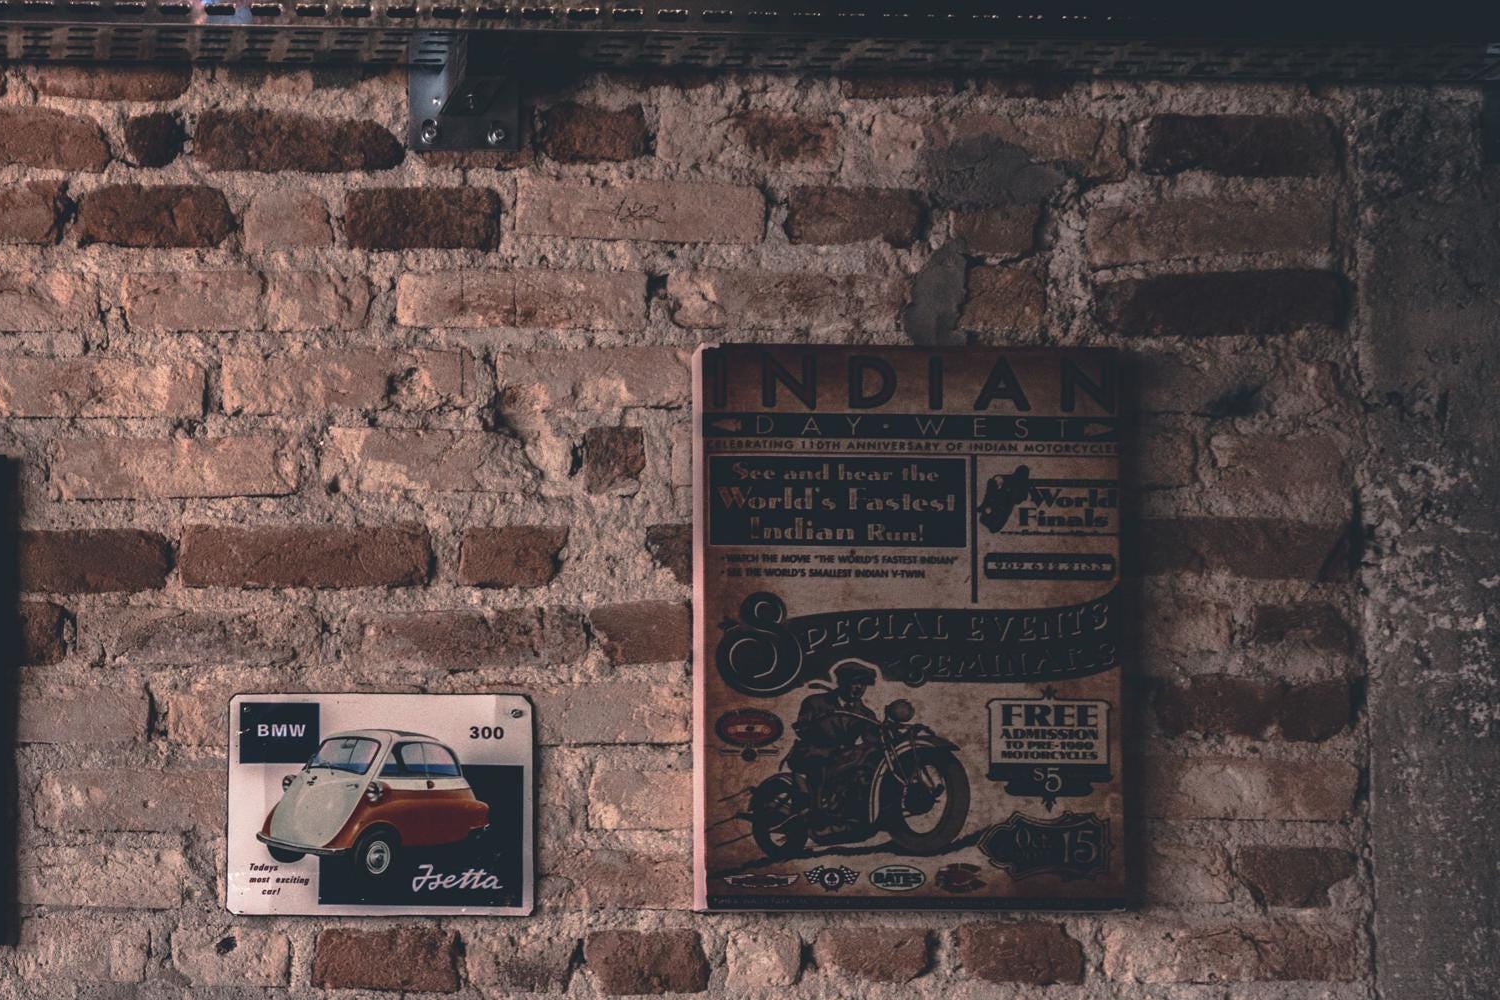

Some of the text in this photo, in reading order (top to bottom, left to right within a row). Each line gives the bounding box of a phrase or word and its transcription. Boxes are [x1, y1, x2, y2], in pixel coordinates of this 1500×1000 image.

[711, 353, 1116, 414] INDIAN
[756, 415, 1071, 439] DAY WEST
[706, 439, 794, 449] CELEBRATING
[801, 440, 841, 450] 110TH
[846, 441, 942, 451] ANNIVERSARY
[945, 442, 963, 451] OF
[969, 442, 1020, 452] INDIAN
[731, 461, 940, 483] See and hear the
[717, 486, 956, 512] World's Fastest
[1028, 487, 1117, 507] World
[1018, 507, 1109, 527] Finals
[750, 515, 924, 542] Indian Run!
[1001, 704, 1098, 727] FREE
[257, 724, 306, 737] BMW
[469, 726, 505, 740] 300
[1000, 728, 1099, 740] ADMISSION
[1005, 741, 1024, 749] TO
[1001, 751, 1098, 760] MOTORCYCLES
[1033, 767, 1062, 793] $5
[1062, 830, 1099, 864] 15
[249, 862, 279, 873] Todays
[275, 875, 310, 886] exciting
